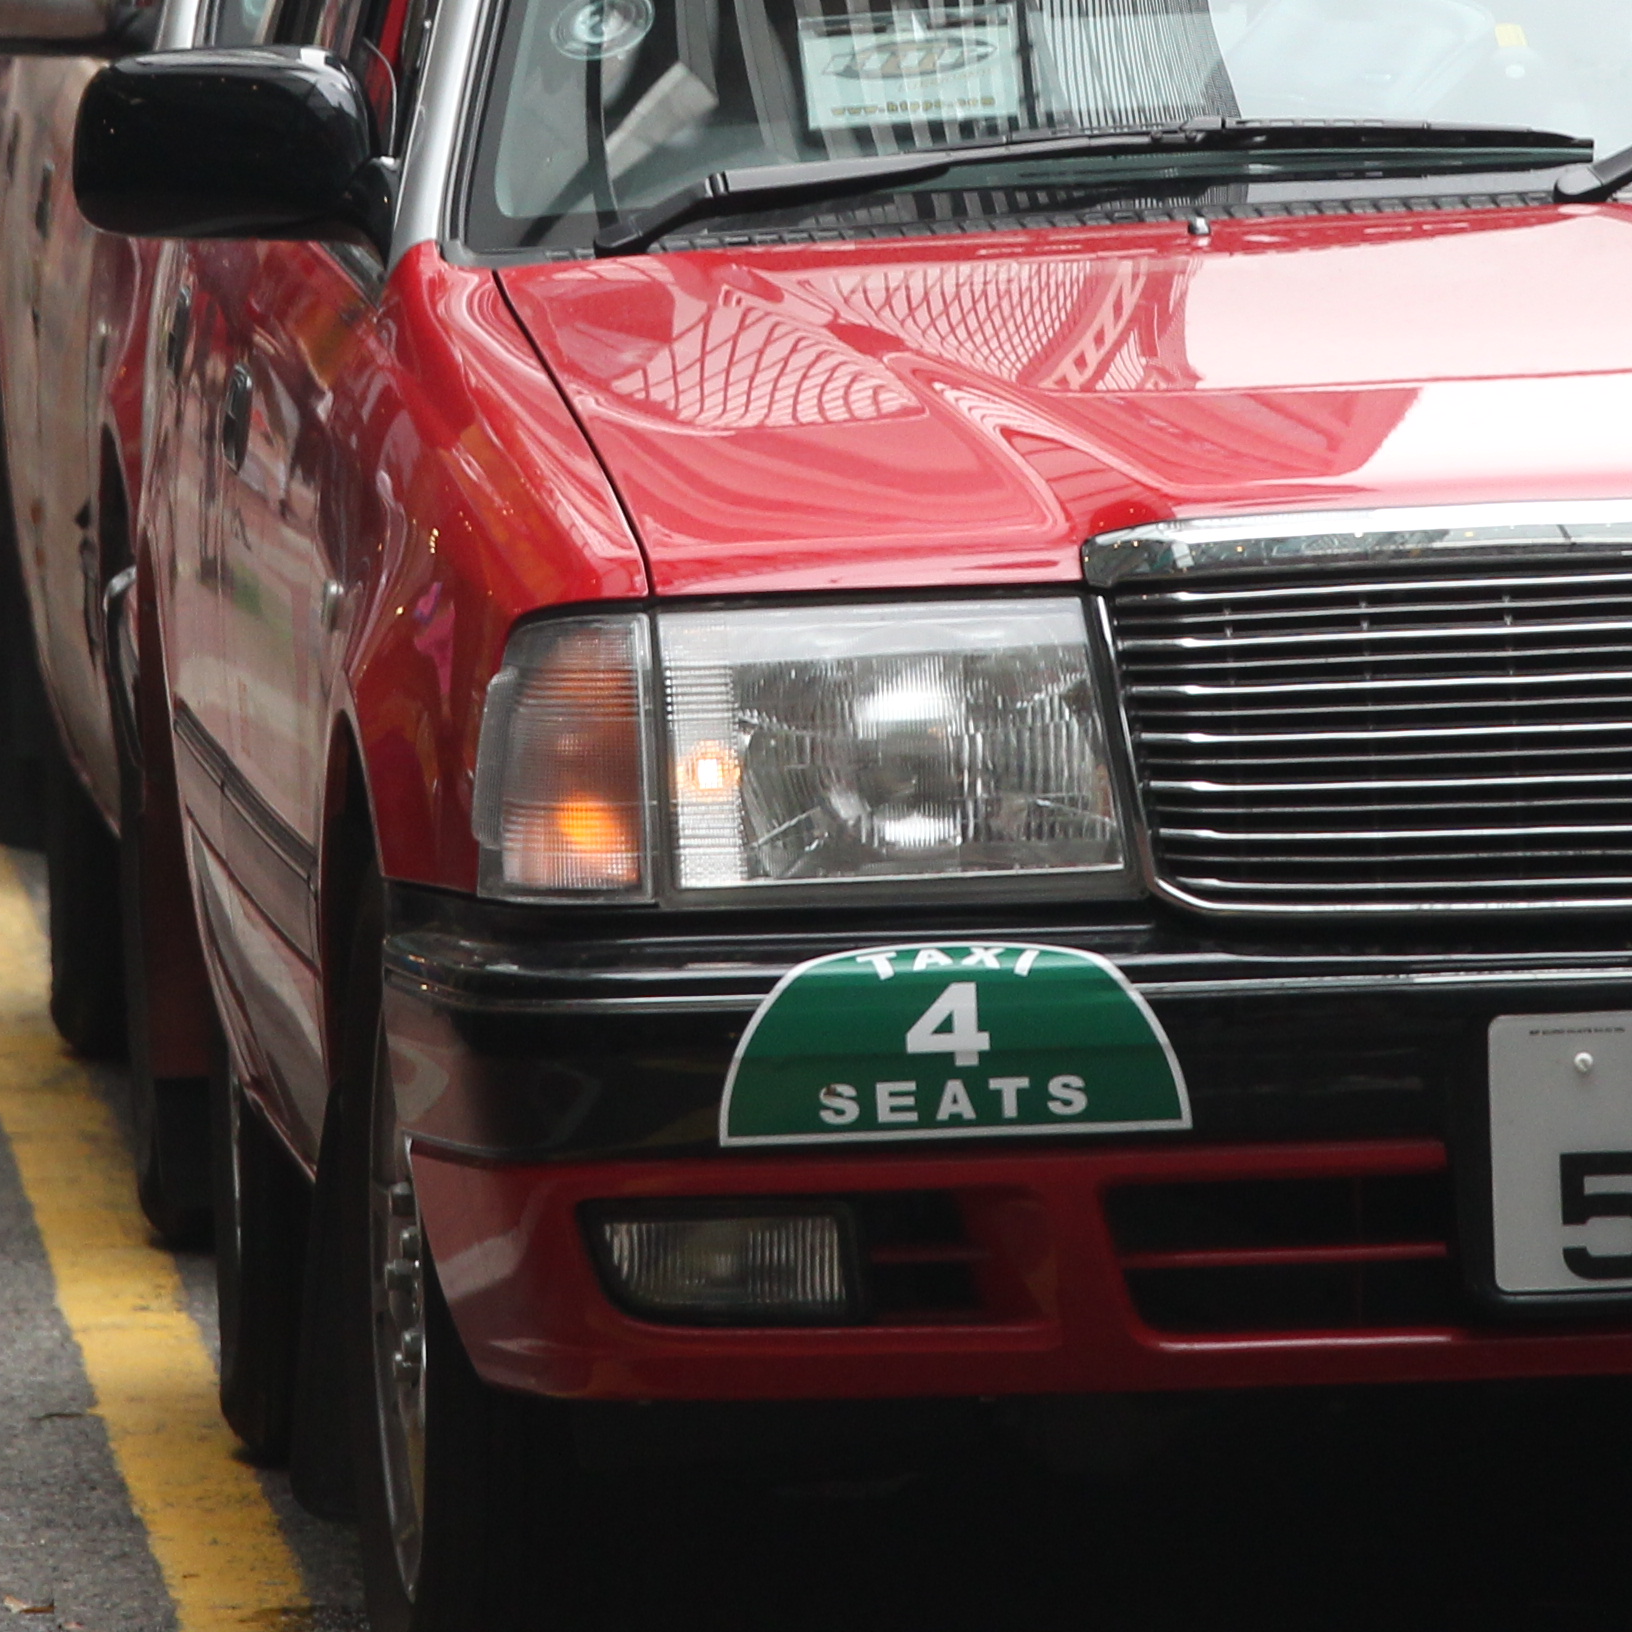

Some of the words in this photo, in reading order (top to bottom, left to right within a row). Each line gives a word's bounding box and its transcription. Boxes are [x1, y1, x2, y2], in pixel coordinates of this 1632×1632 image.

[855, 946, 1040, 981] TAXI
[905, 981, 991, 1067] 4
[818, 1074, 1089, 1125] SEATS
